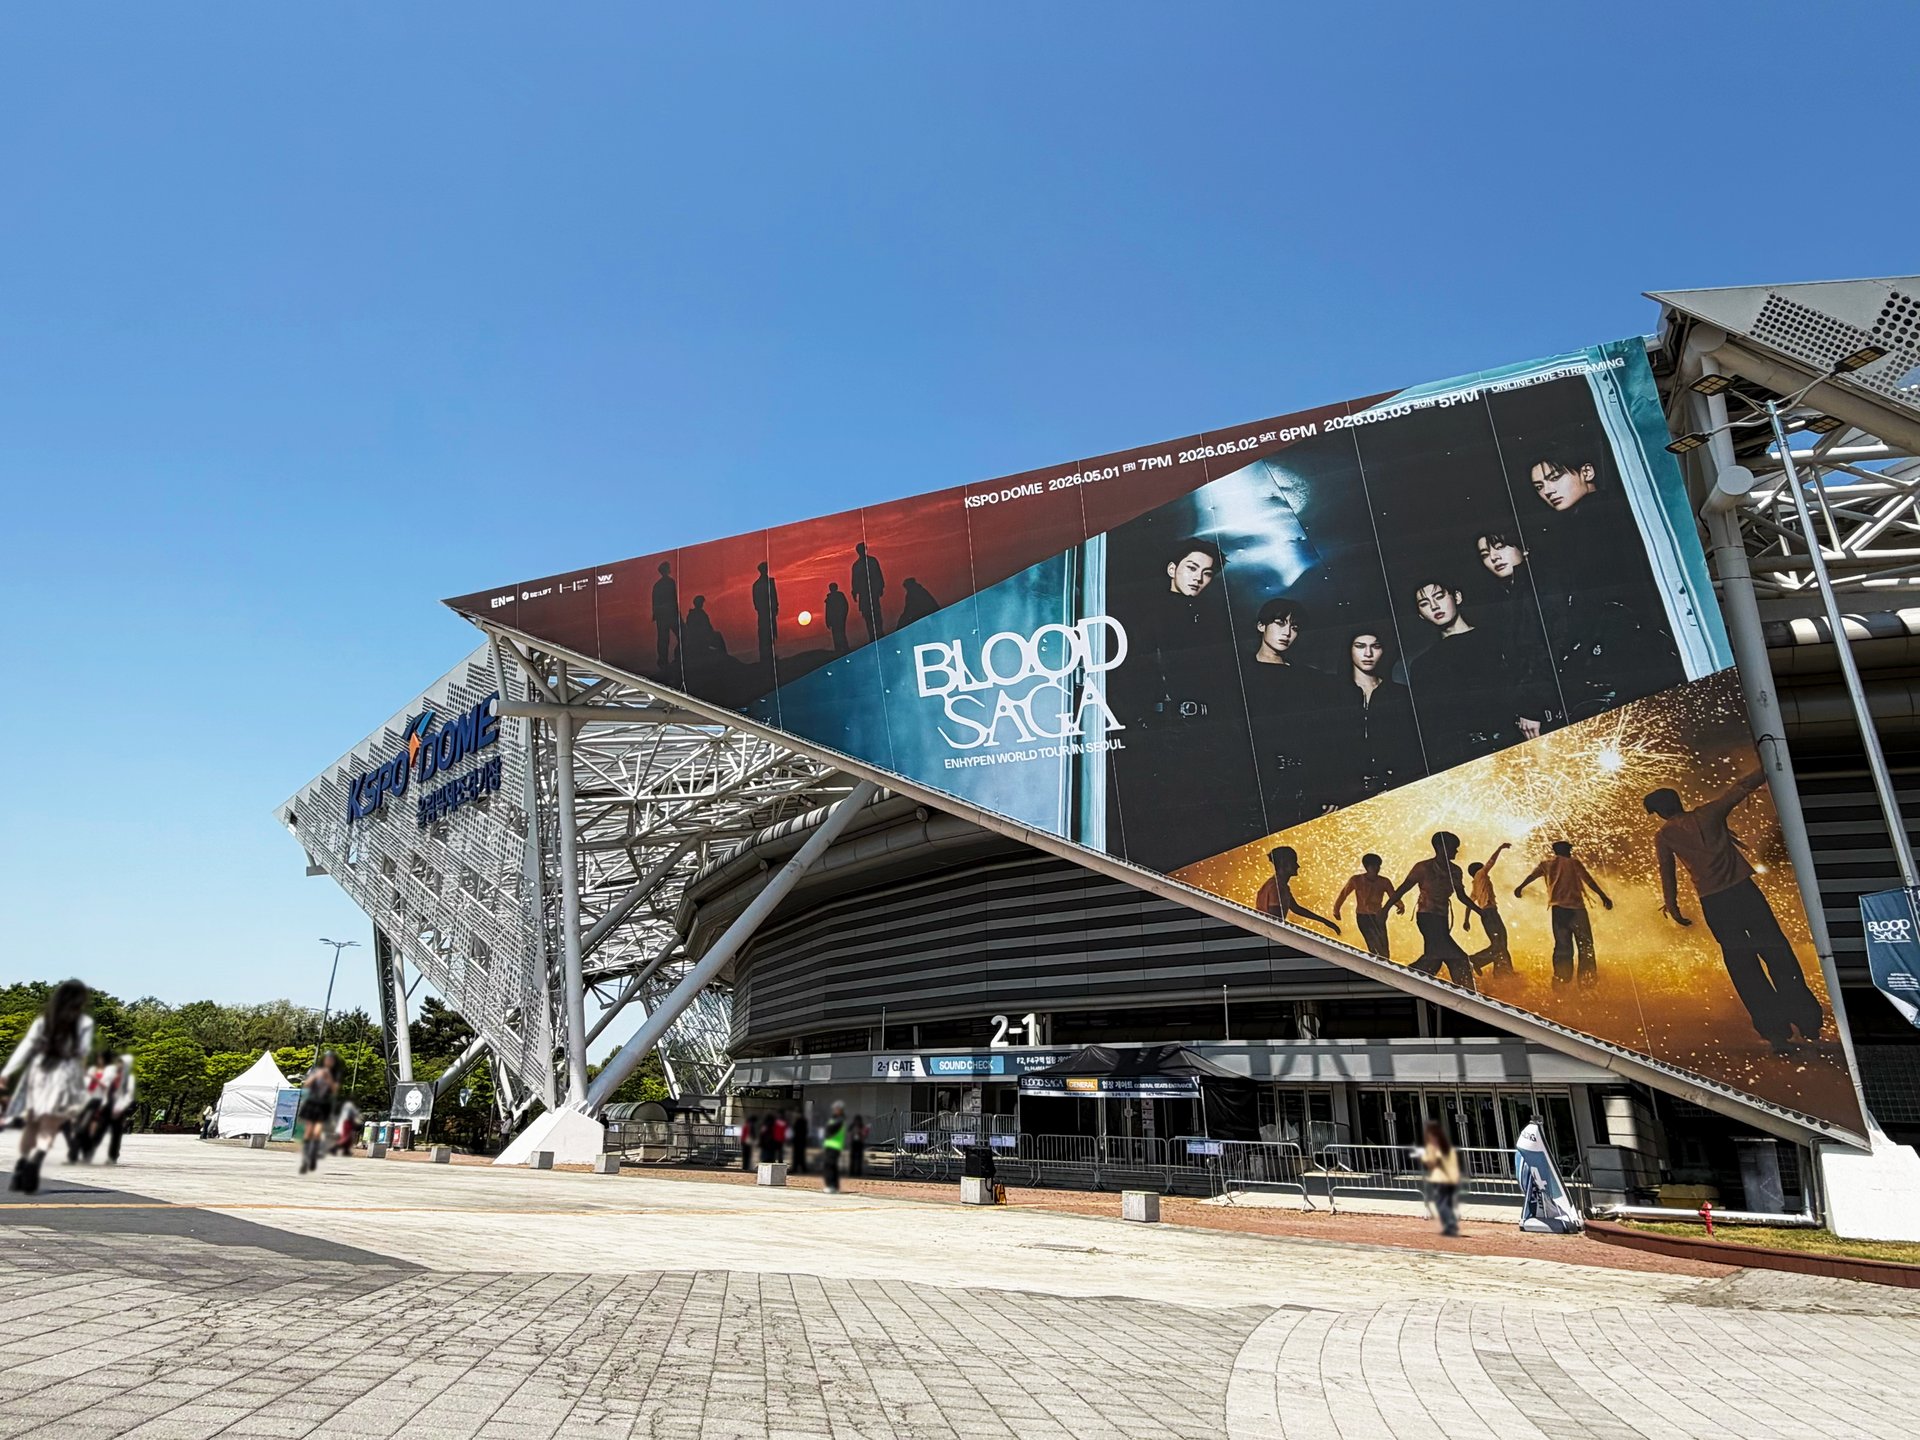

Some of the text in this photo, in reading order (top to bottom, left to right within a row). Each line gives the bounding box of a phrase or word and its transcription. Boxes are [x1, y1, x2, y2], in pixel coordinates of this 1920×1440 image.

[964, 357, 1626, 509] KSPO DOME 2026.05.01 FRI 7PM 2026.05.02 SAT 6PM 2026.05.03 SUN 5PM ONLINE LIVE STREAMING
[914, 615, 1128, 697] BLOOD
[937, 677, 1126, 749] SAGA
[347, 690, 500, 825] KSPO DOME
[944, 738, 1126, 769] ENHYPEN WORLD TOUR IN SEOUL
[1867, 919, 1910, 932] BLOOD
[1872, 930, 1911, 940] SAGA
[990, 1013, 1036, 1048] 2-1
[877, 1060, 916, 1072] 2-1 GATE
[1021, 1078, 1044, 1087] BLOOD
